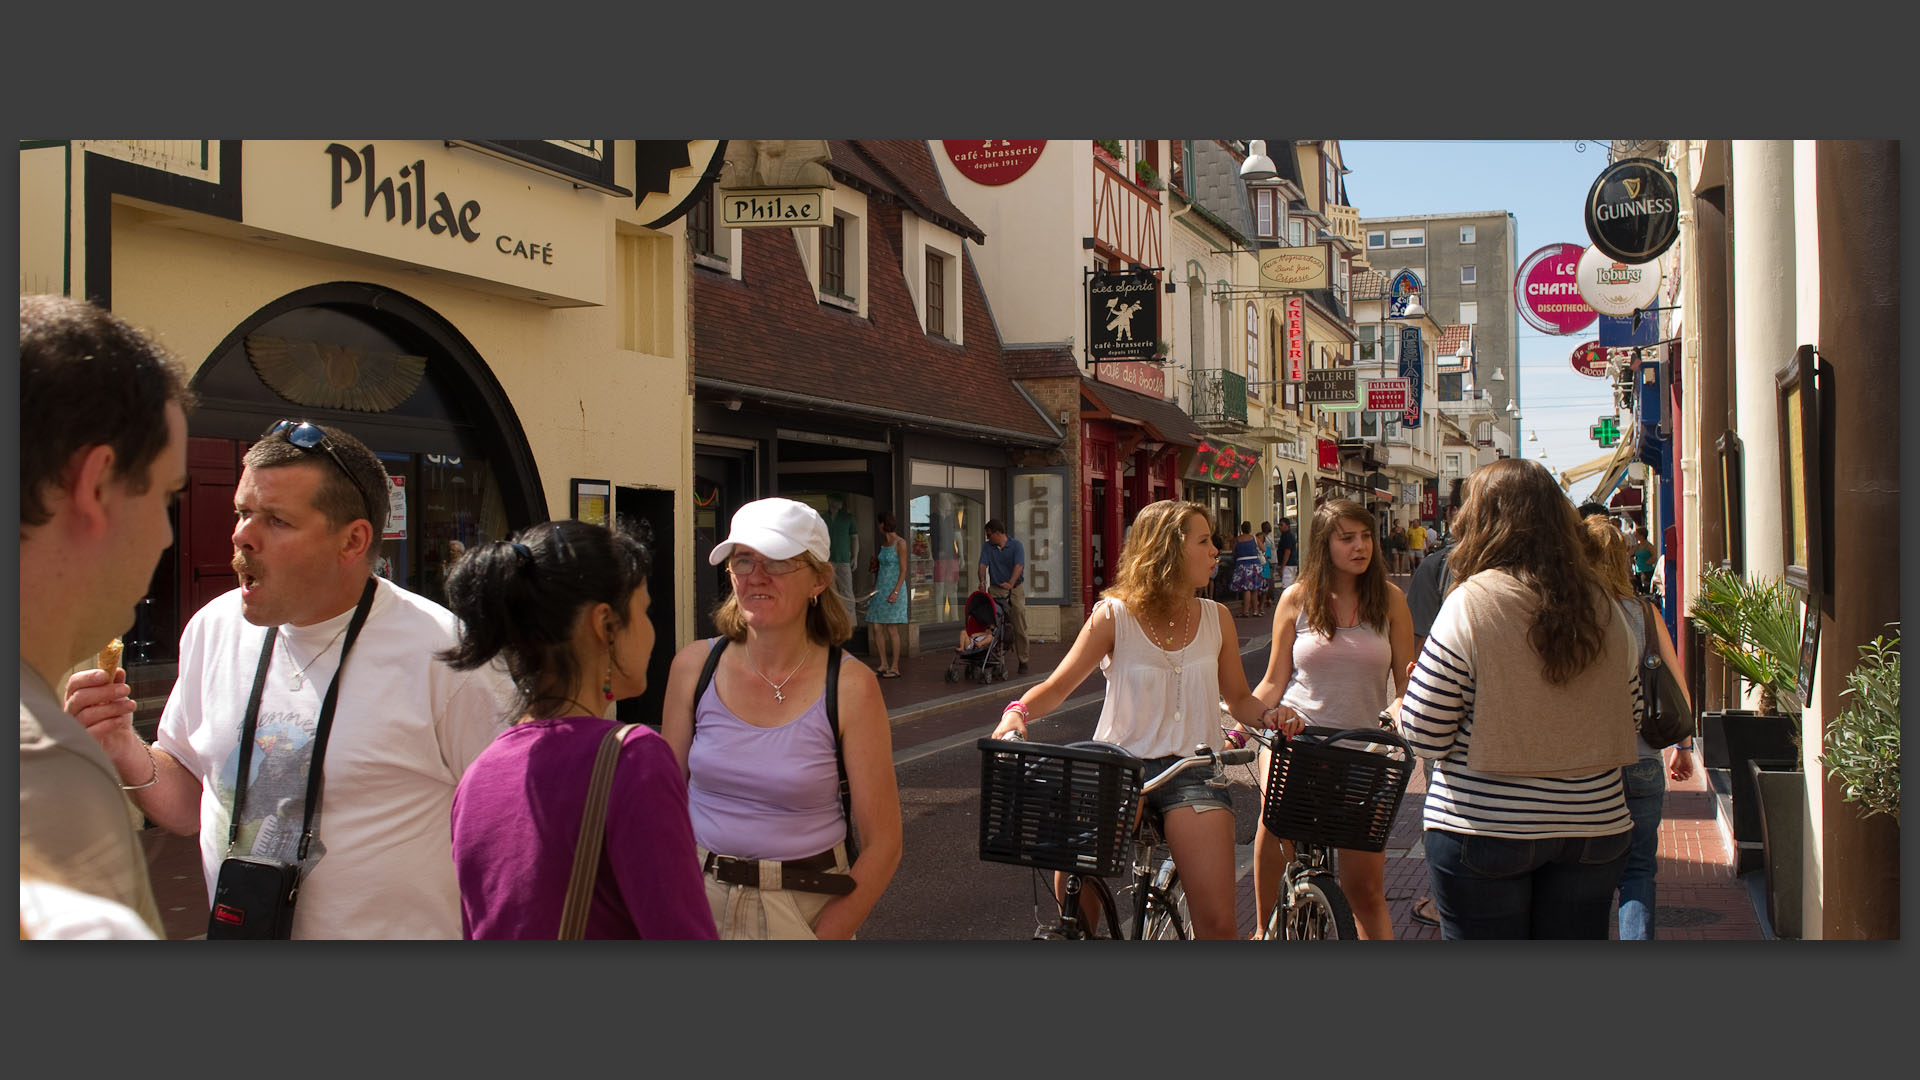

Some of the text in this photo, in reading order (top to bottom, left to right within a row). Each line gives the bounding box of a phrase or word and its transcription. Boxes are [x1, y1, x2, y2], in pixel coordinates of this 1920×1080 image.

[974, 159, 1018, 170] depuis 1911
[324, 143, 481, 243] Philae
[734, 197, 811, 220] Philae
[1596, 198, 1673, 221] GUINNESS
[495, 235, 553, 265] CAFÉ
[1556, 263, 1576, 275] LE
[1597, 268, 1641, 285] Loburg
[1528, 283, 1581, 295] CHATH
[1288, 297, 1302, 380] CREPERIE
[1122, 366, 1137, 385] des
[1307, 371, 1355, 382] GALERIE
[1324, 382, 1336, 390] DE
[1306, 390, 1355, 400] VILLIERS
